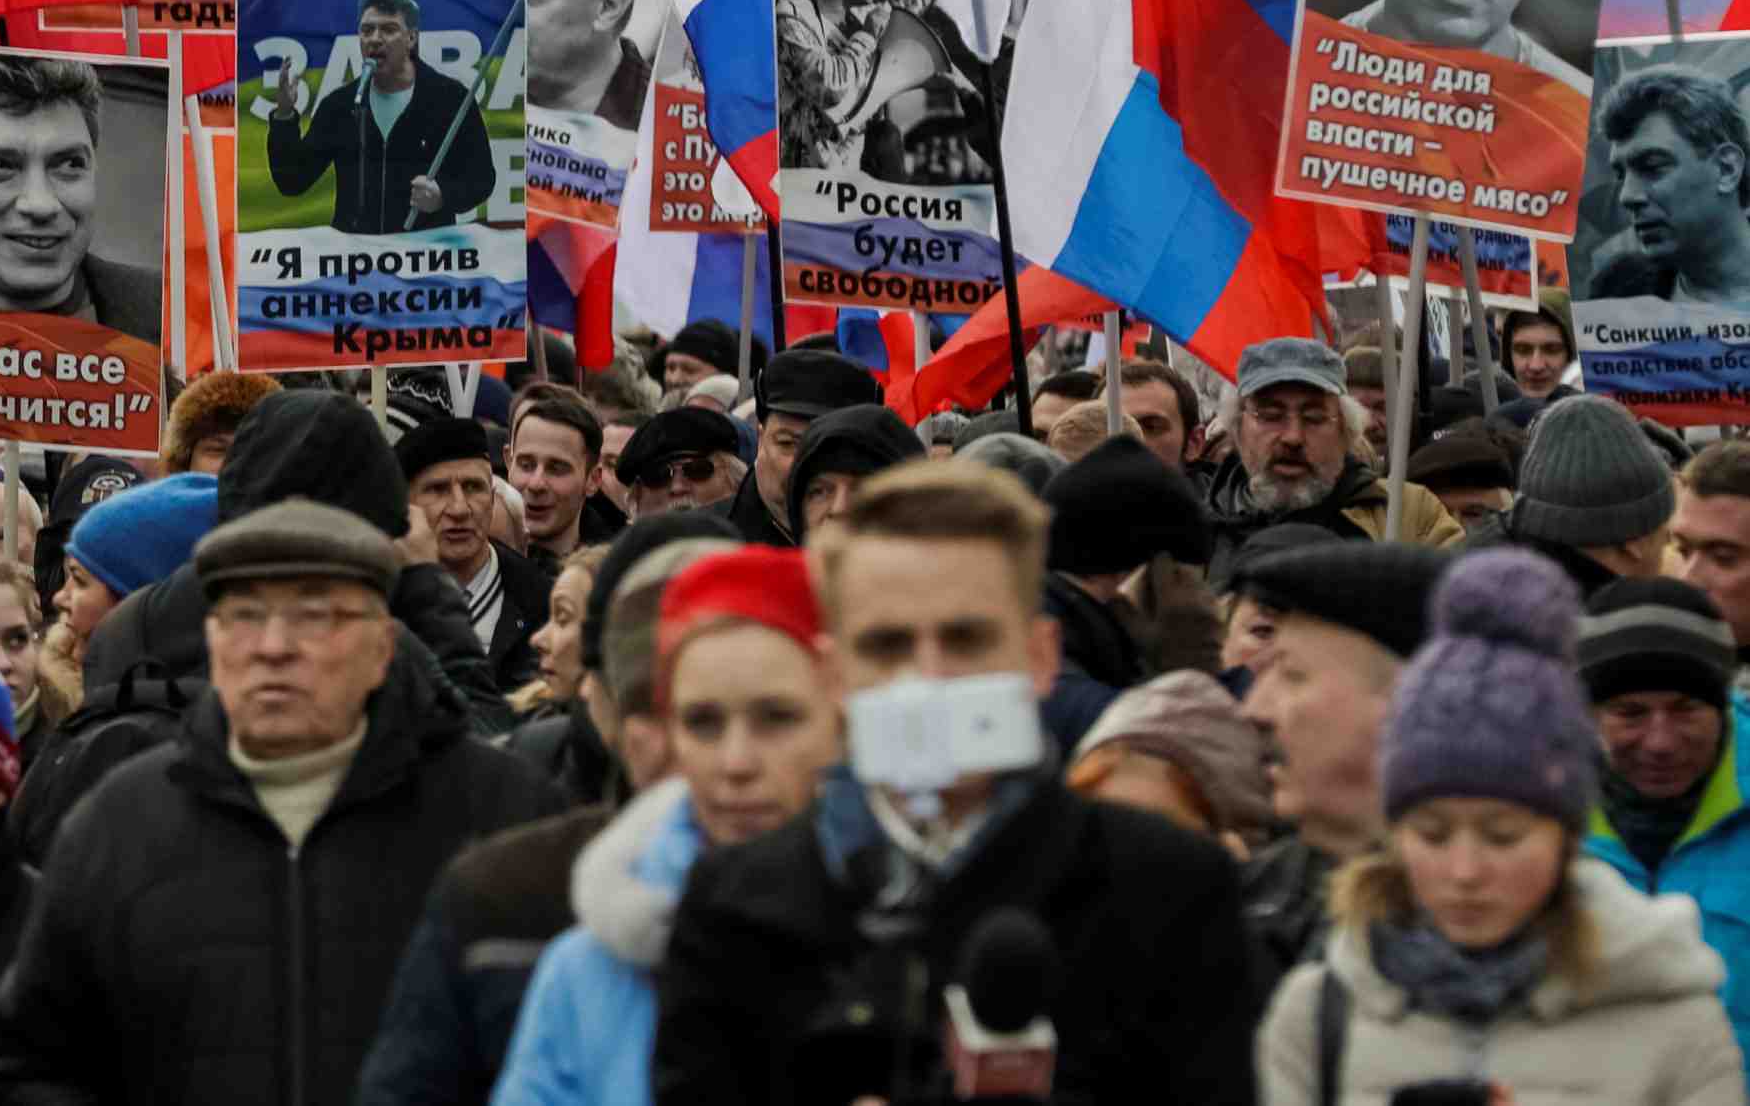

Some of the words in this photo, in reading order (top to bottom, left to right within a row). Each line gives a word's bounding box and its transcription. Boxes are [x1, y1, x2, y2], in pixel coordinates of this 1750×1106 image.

[1317, 38, 1425, 85] “Люди
[1431, 65, 1491, 95] для
[1309, 82, 1496, 133] российской
[1306, 119, 1414, 156] власти
[663, 171, 706, 192] это
[815, 180, 963, 222] “Россия
[1301, 156, 1466, 203] пушечное
[1473, 184, 1569, 217] мясо”
[661, 202, 704, 222] это
[853, 222, 964, 266] будет
[250, 246, 302, 280] “Я
[318, 247, 480, 285] против
[261, 285, 483, 319] аннексии
[333, 314, 517, 361] Крыма”
[1583, 322, 1701, 344] “Санкции,
[55, 352, 126, 384] все
